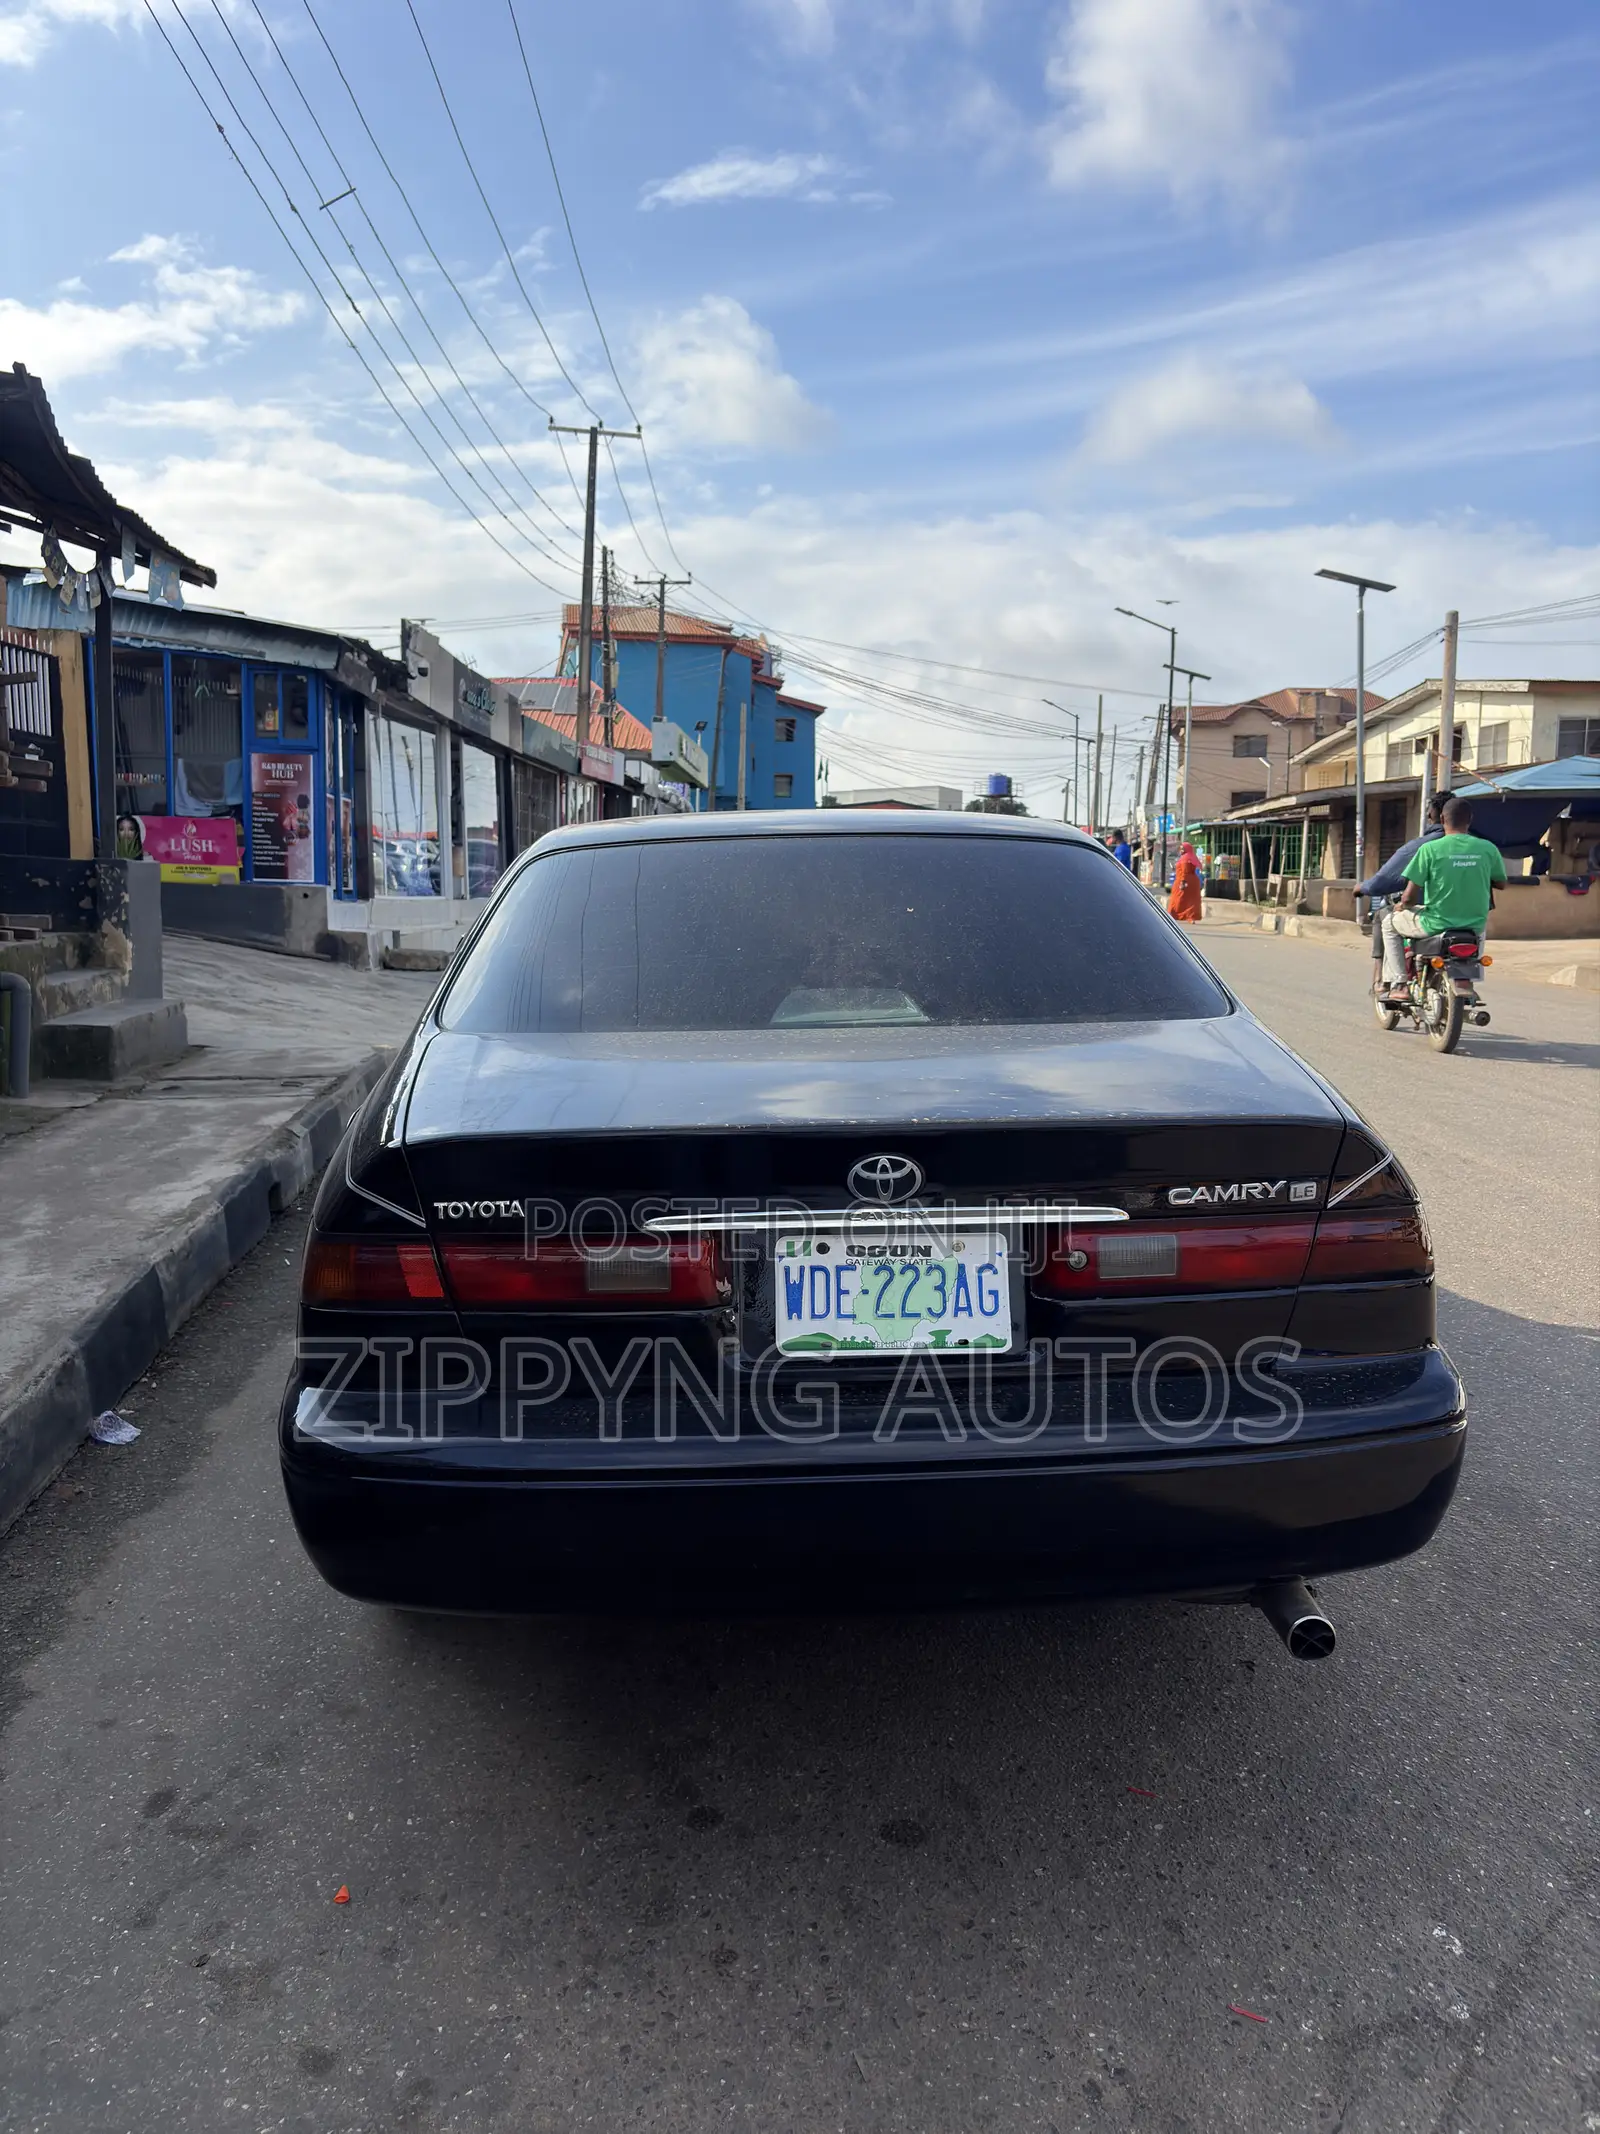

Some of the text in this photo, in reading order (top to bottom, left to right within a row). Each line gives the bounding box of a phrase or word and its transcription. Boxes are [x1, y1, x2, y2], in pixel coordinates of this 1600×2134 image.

[277, 763, 304, 771] BEAUTY
[271, 770, 294, 779] HUB
[170, 838, 214, 853] LUSH
[1168, 1180, 1316, 1205] CAMRY LE
[433, 1200, 525, 1219] TOYOTA
[851, 1211, 929, 1221] CAMRY
[845, 1245, 933, 1257] OGUN
[845, 1259, 933, 1267] GATEWAY STATE
[784, 1262, 1000, 1321] WDE-223AG
[837, 1341, 870, 1349] EDERAL
